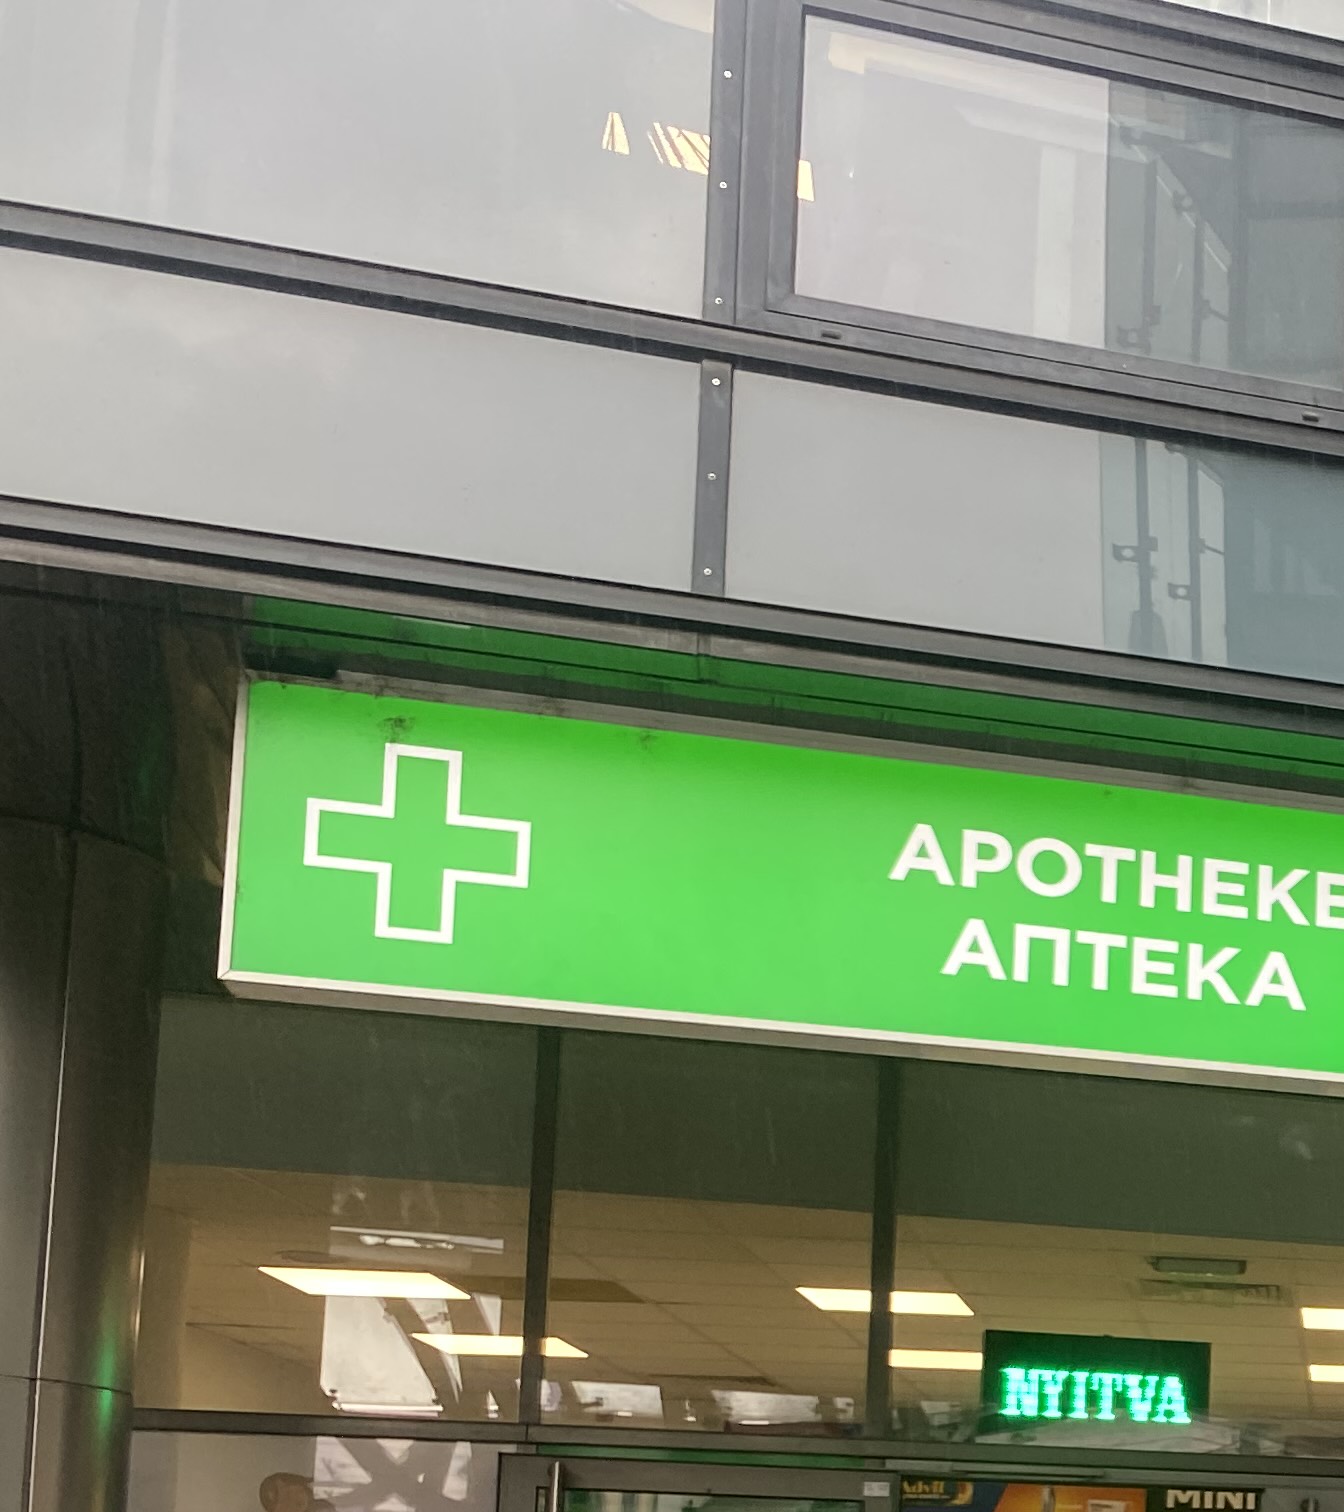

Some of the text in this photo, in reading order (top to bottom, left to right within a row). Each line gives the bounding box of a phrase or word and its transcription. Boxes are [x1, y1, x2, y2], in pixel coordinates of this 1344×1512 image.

[940, 918, 1306, 1011] АПТЕКА
[999, 1367, 1191, 1423] NYITVA
[1166, 1489, 1256, 1510] MINI
